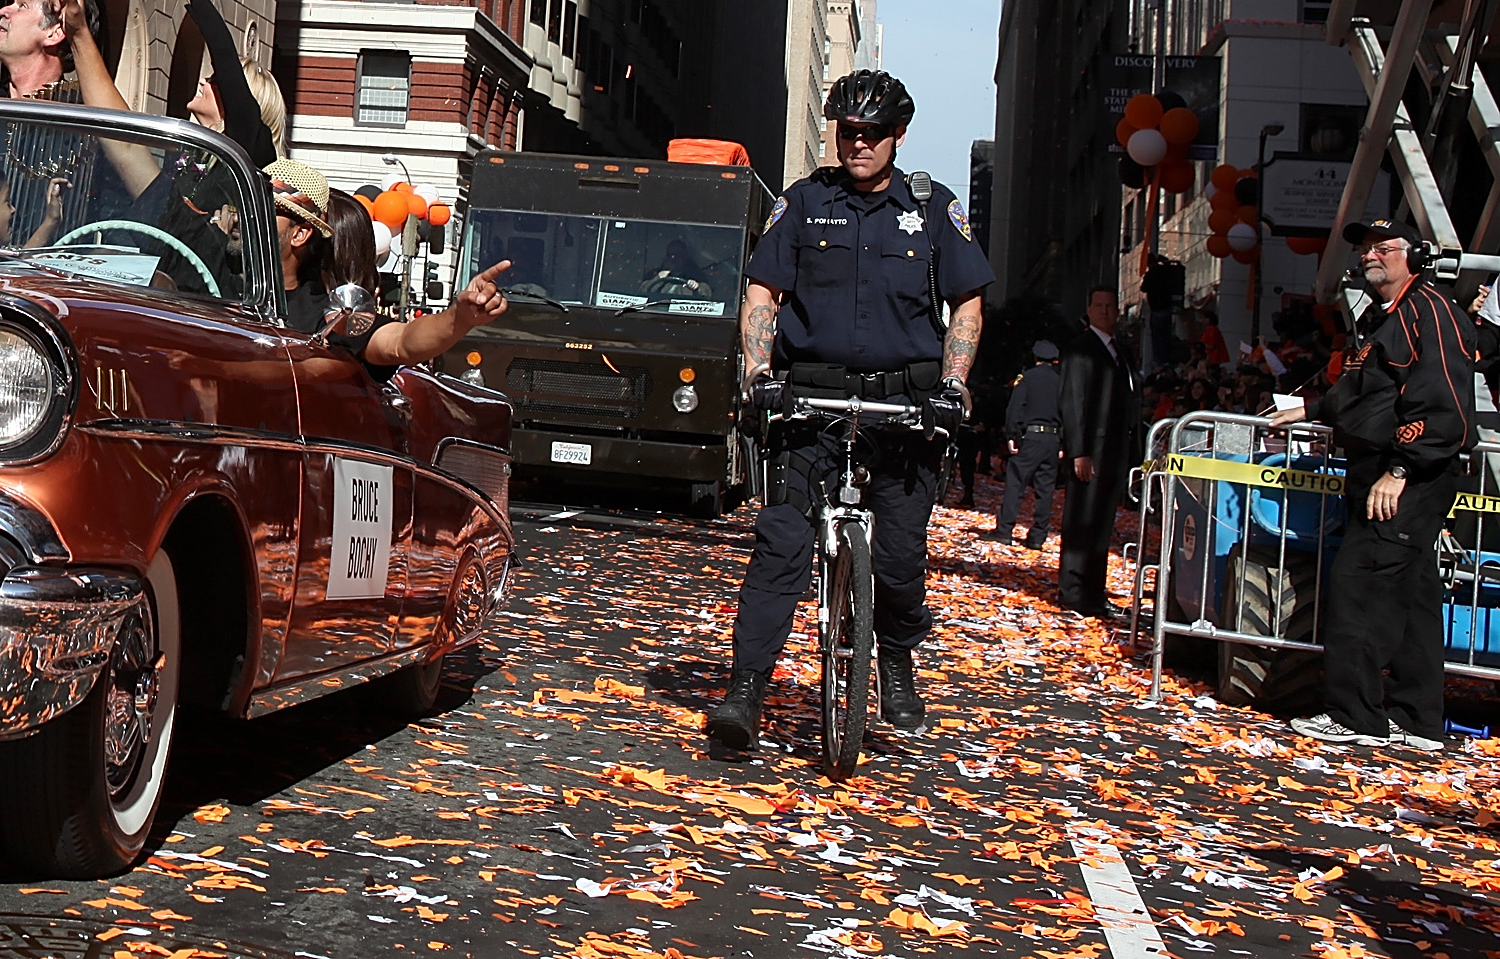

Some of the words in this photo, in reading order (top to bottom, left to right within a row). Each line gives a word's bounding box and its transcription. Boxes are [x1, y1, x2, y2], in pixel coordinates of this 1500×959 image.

[1110, 88, 1130, 96] THE
[602, 298, 638, 306] GIANTS
[679, 305, 715, 313] GIANTS
[1260, 469, 1343, 493] CAUTIO
[351, 478, 379, 523] BRUCE
[347, 536, 378, 579] BOCHY
